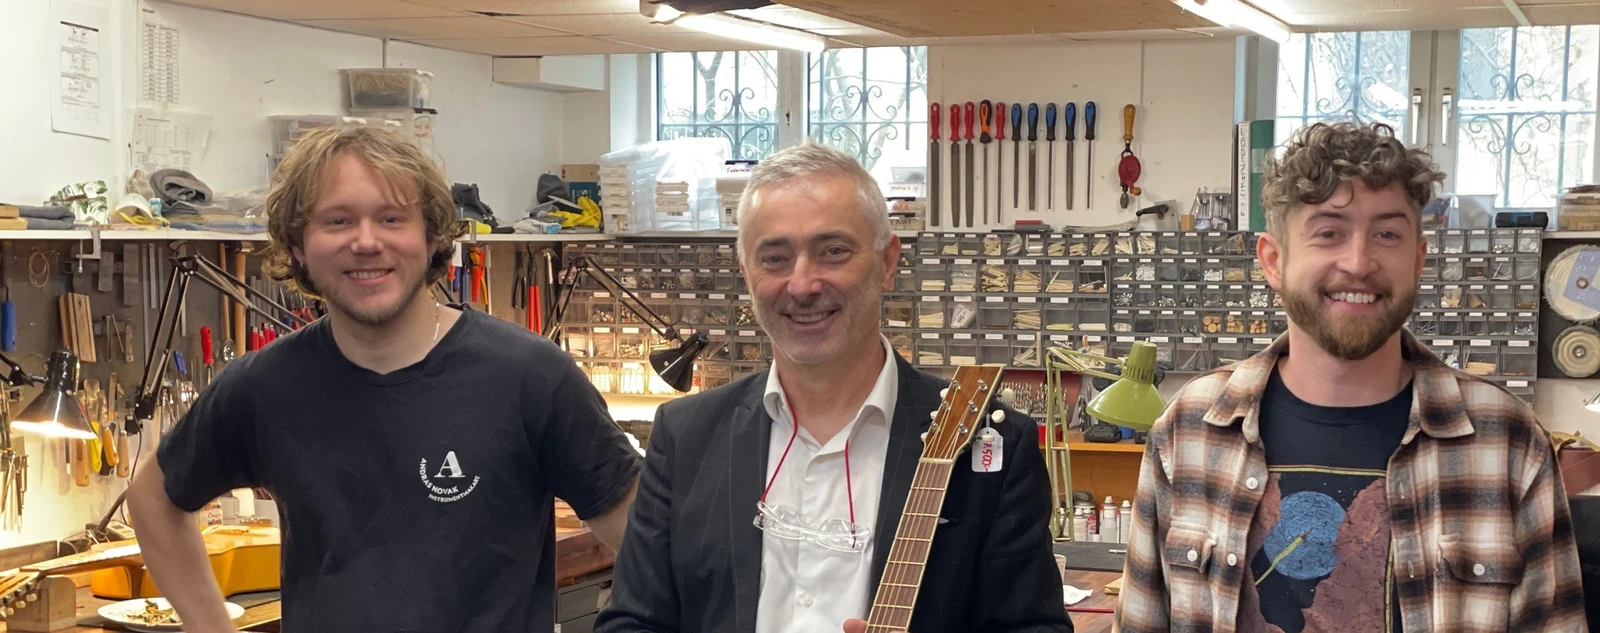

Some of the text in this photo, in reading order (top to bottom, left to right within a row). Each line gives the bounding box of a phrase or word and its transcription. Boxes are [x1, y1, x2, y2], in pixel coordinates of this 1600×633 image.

[419, 457, 459, 495] ANDRAS NOVAK
[433, 450, 466, 478] A
[428, 475, 480, 503] INSTRUMENTMAKARE
